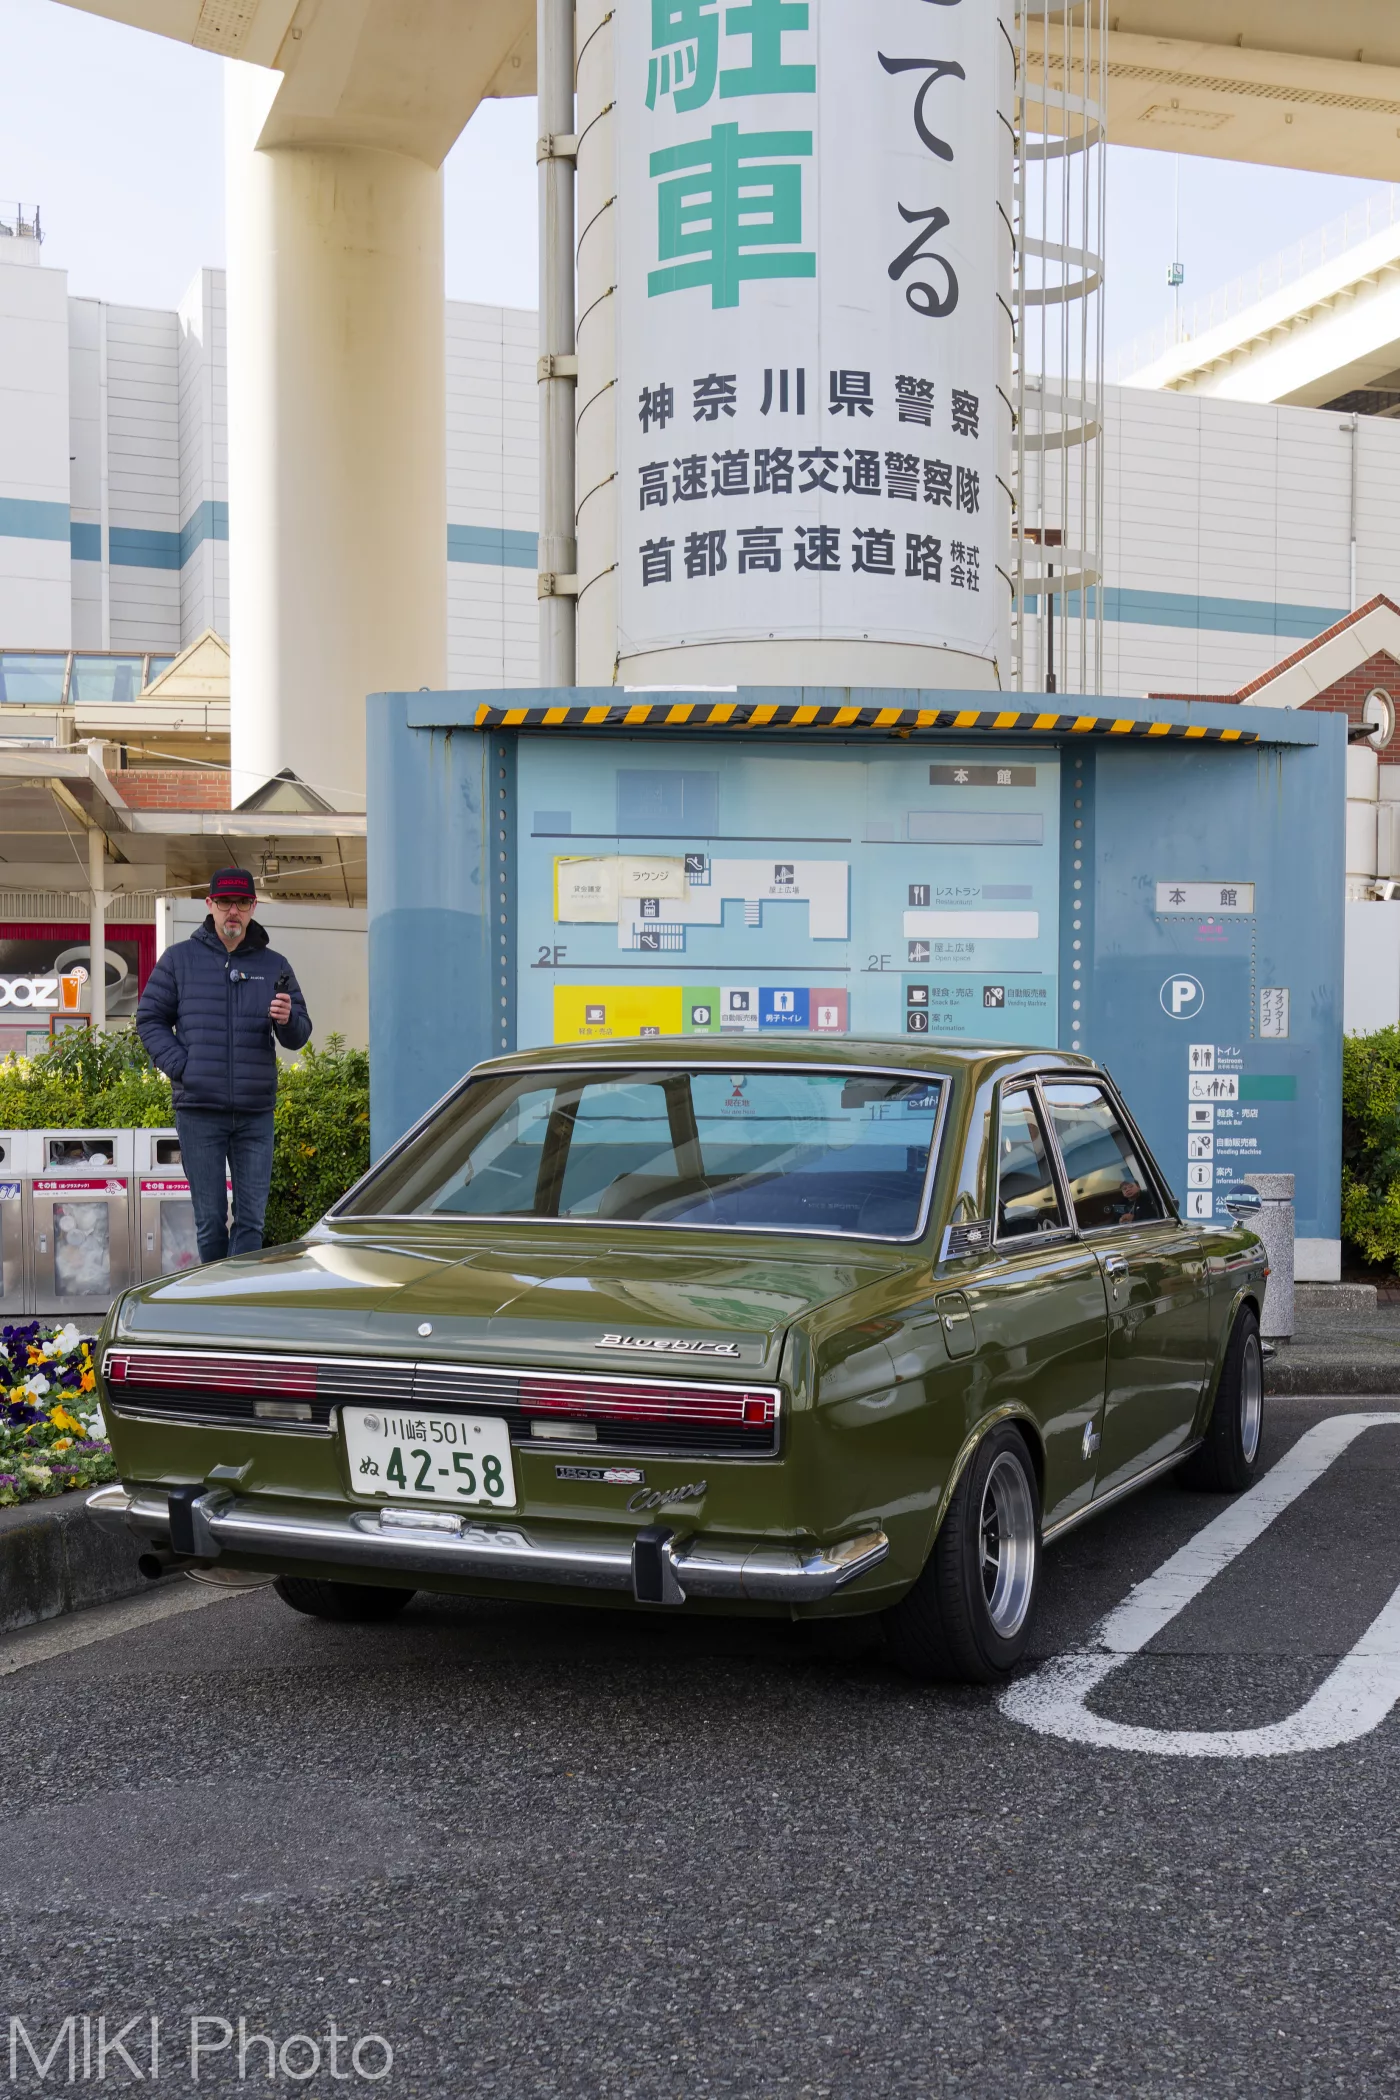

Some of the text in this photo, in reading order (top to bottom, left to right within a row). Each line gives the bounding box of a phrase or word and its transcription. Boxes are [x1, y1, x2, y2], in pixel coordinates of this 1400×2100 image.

[645, 0, 817, 310] 駐車
[877, 0, 966, 318] てる
[639, 368, 979, 439] 神奈川県警察
[638, 446, 979, 514] 高速道路交通警察隊
[954, 769, 1011, 785] 本館
[632, 871, 669, 881] ラウンジ
[769, 886, 799, 894] 屋上広場
[935, 887, 980, 897] レストラン
[1169, 888, 1237, 906] 本館
[934, 943, 975, 953] 屋上広場
[538, 946, 567, 966] 2F
[935, 954, 952, 962] Open
[868, 955, 891, 971] 2F
[1007, 989, 1047, 998] 自動販売機
[1172, 981, 1197, 1013] P
[1262, 990, 1272, 1027] ダイコク
[721, 1014, 758, 1022] 自動販売機
[765, 1014, 802, 1022] 男子トイレ
[931, 1013, 953, 1022] 案内
[1217, 1046, 1241, 1056] トイレ
[869, 1105, 891, 1120] 1F
[1216, 1138, 1258, 1147] 自動販売機
[1216, 1148, 1239, 1156] Vending
[1216, 1167, 1233, 1176] 案内
[601, 1333, 740, 1353] Bluebird
[386, 1447, 505, 1498] 42-58
[559, 1468, 601, 1480] 1800
